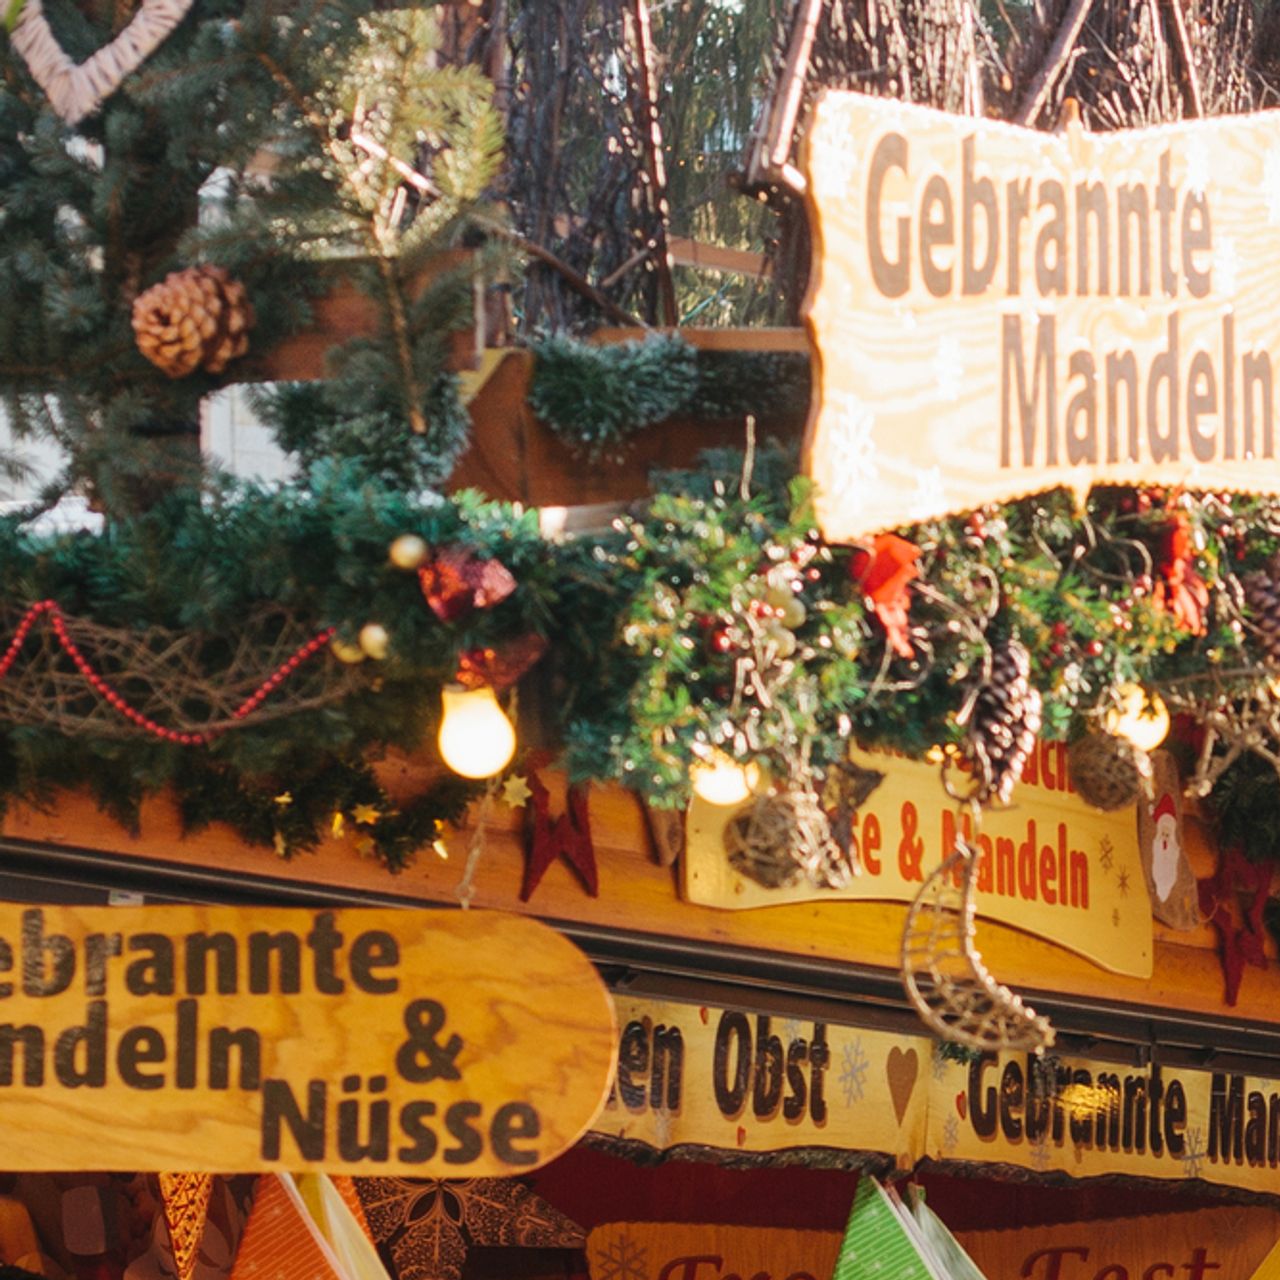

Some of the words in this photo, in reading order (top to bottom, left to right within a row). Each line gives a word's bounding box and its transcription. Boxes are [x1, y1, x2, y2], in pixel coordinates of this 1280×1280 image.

[865, 131, 1213, 299] Gebrannte
[1000, 312, 1275, 468] Mandeln
[898, 800, 924, 882] &
[942, 808, 1090, 910] Mandeln
[0, 908, 400, 997] brannte
[395, 999, 464, 1083] &
[713, 1010, 830, 1124] Obst
[261, 1074, 541, 1165] Nüsse
[967, 1052, 1188, 1155] Gebrannte
